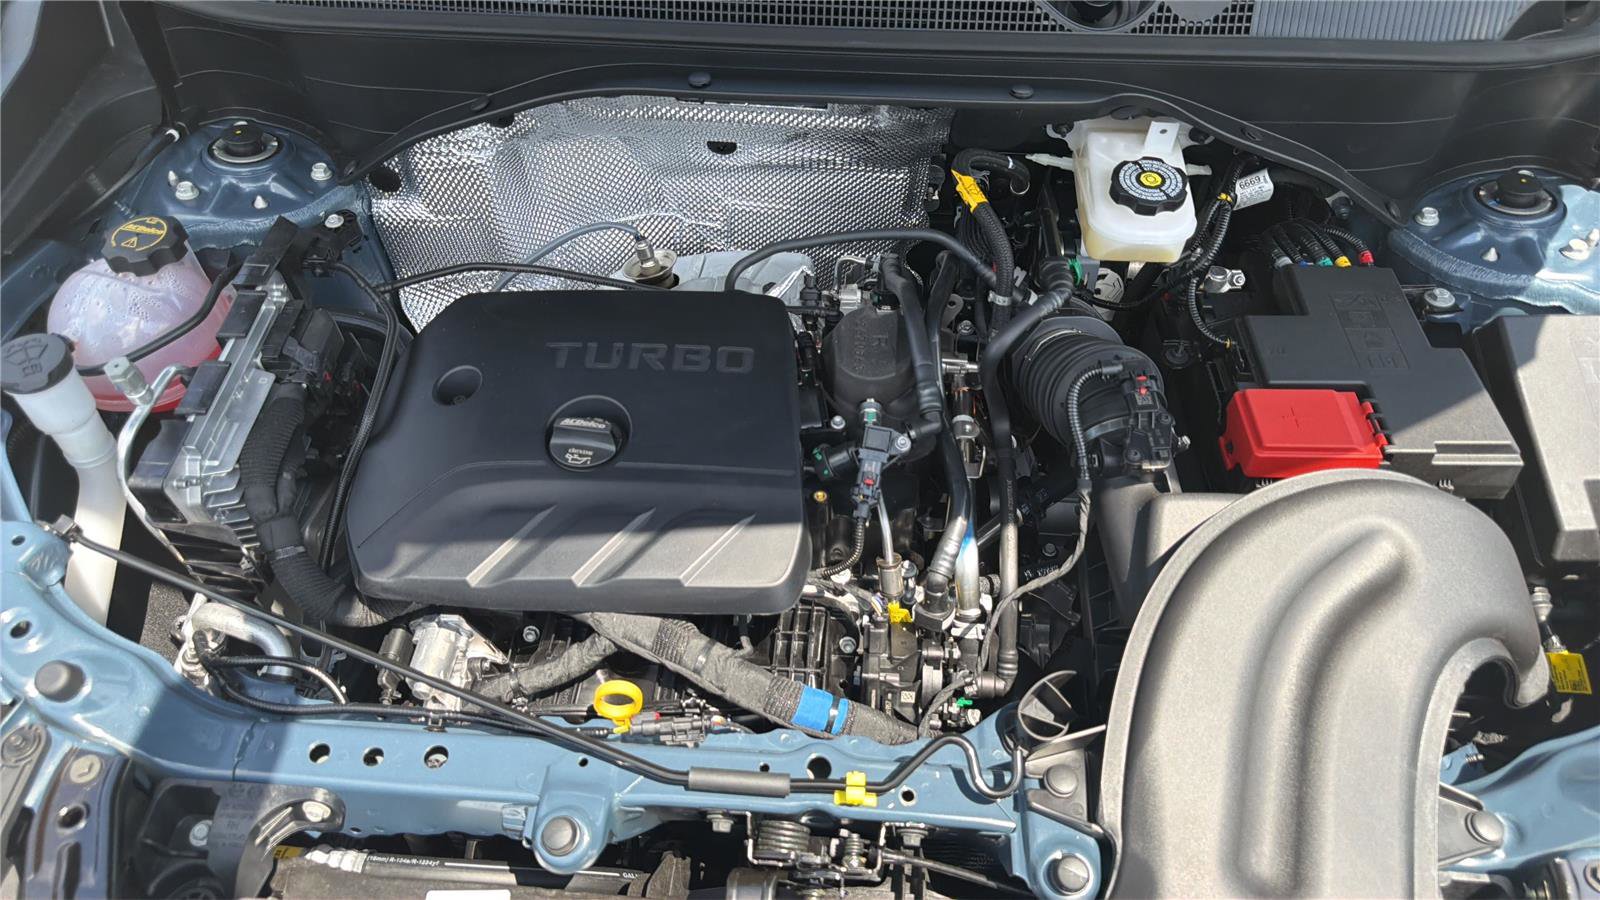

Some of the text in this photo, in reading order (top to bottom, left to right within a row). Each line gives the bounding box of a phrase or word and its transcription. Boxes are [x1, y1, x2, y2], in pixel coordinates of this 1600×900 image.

[1239, 175, 1261, 190] 6669
[545, 341, 755, 374] TURBO
[560, 417, 606, 429] ACDelco
